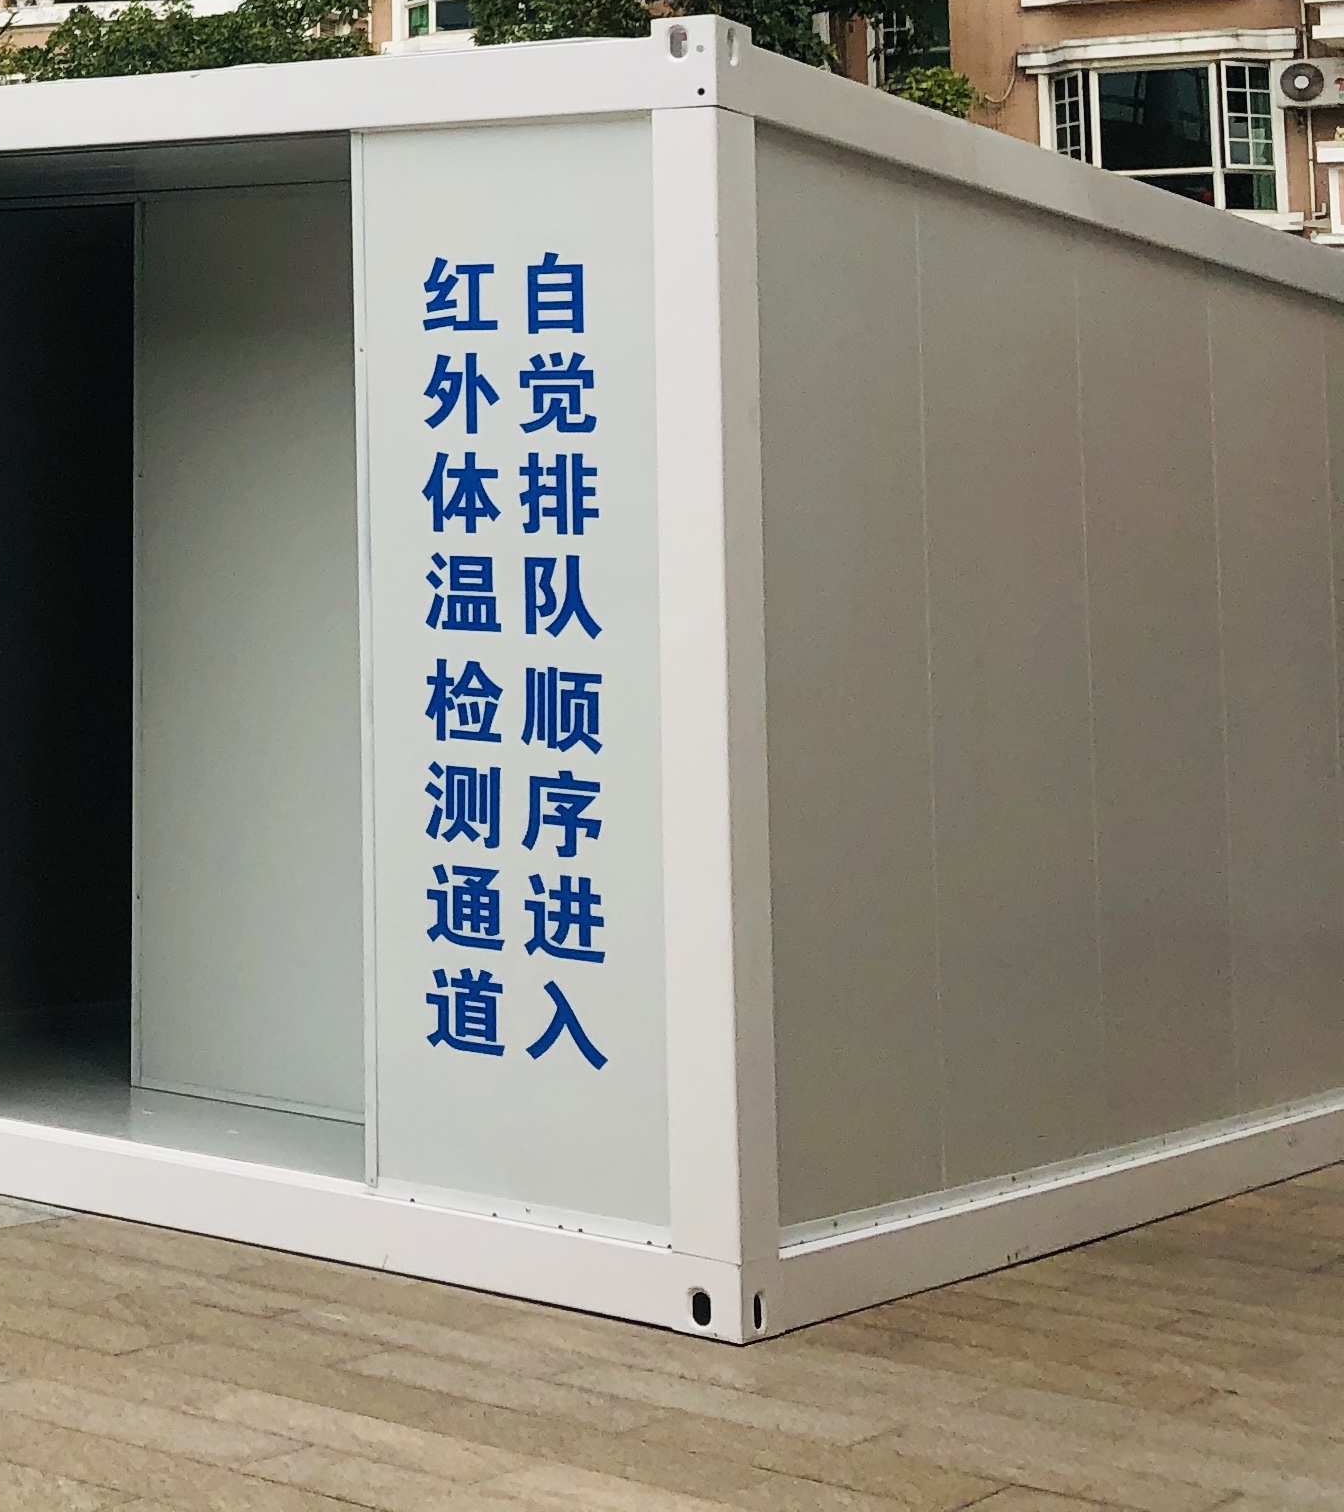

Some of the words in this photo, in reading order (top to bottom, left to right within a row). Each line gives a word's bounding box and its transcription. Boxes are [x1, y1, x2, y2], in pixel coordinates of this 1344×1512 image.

[422, 257, 505, 1057] 红外体温检测通道
[518, 251, 608, 1070] 自觉排队顺序进入
